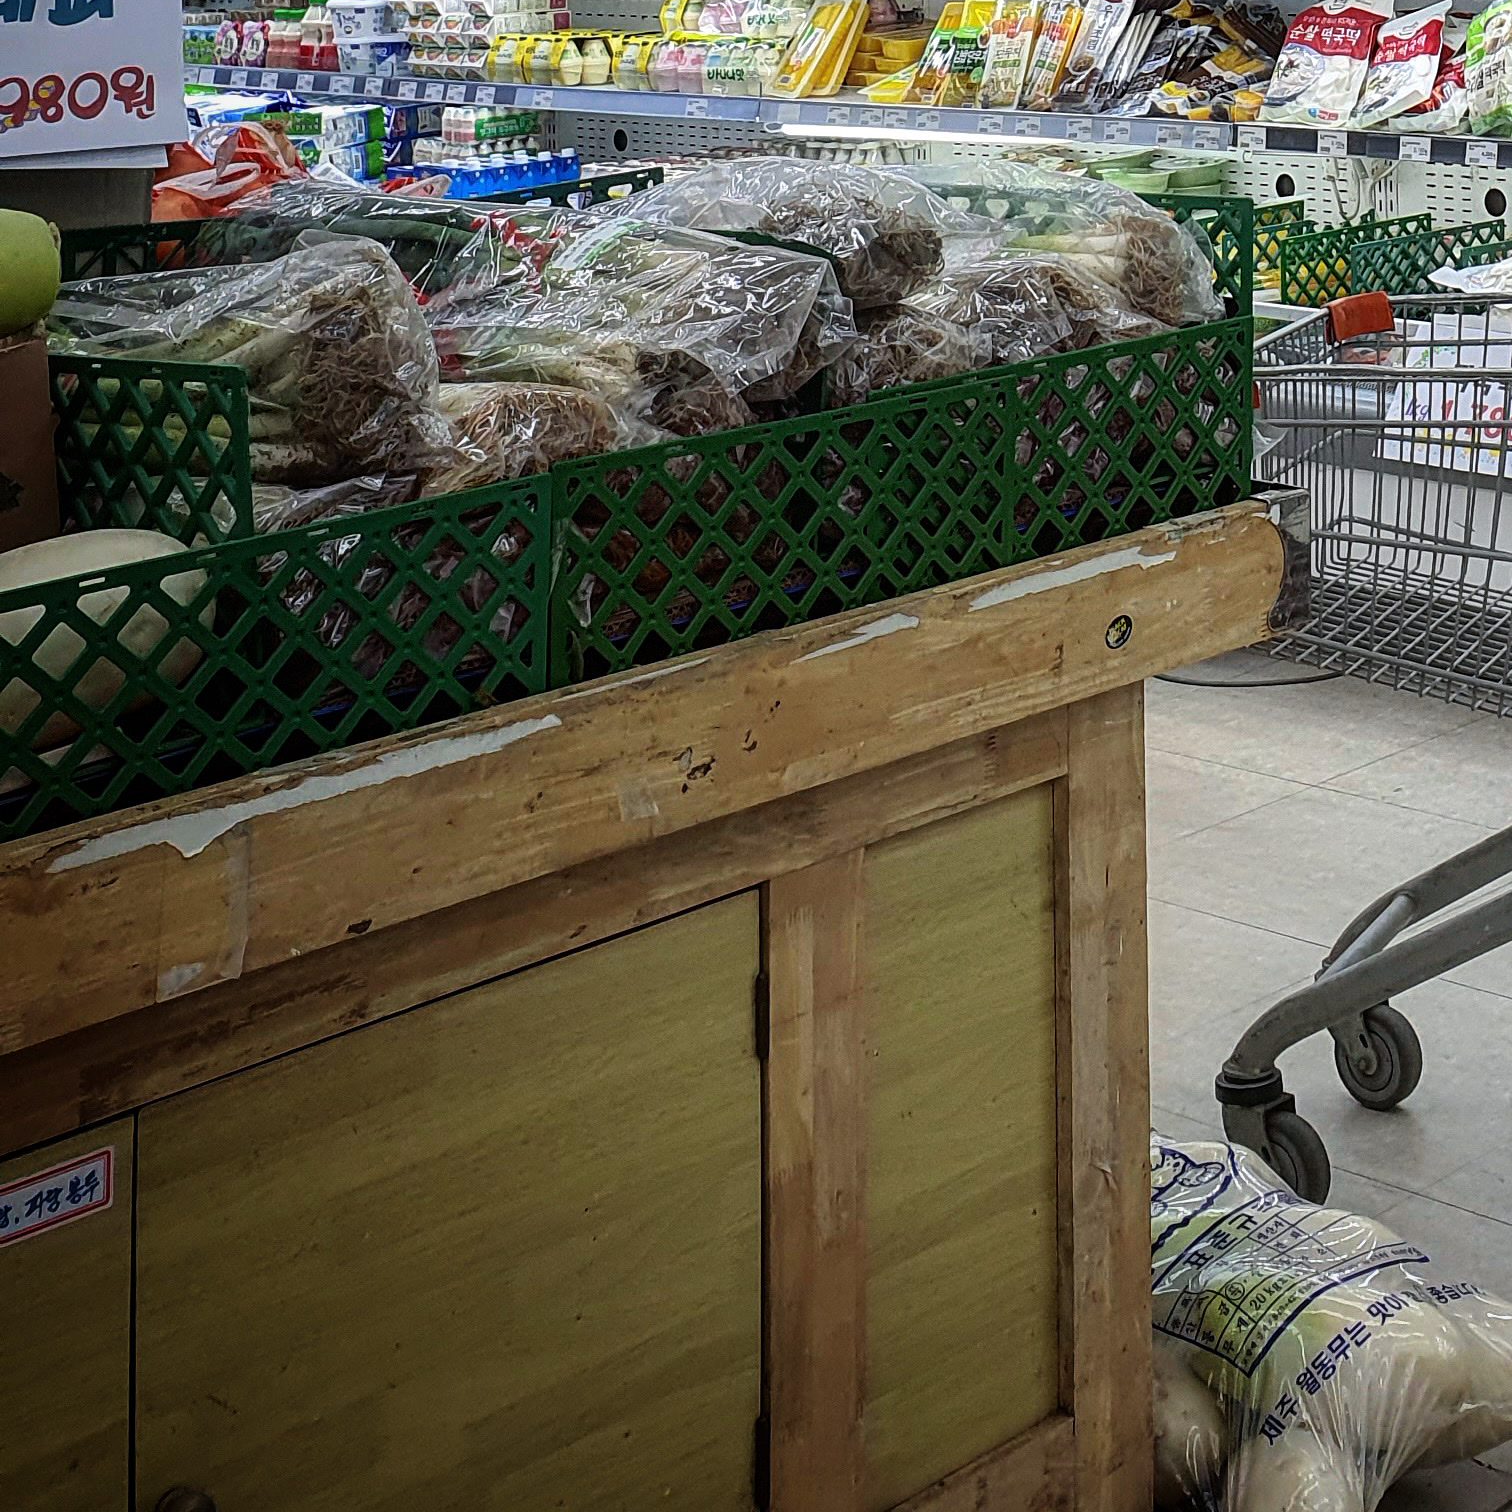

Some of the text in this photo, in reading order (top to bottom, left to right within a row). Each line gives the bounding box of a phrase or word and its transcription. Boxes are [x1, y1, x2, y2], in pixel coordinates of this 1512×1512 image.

[1320, 28, 1361, 46] 떡국떡
[1259, 1395, 1300, 1446] 제주
[1295, 1322, 1373, 1396] 월동무는
[1366, 1290, 1408, 1327] 맛이
